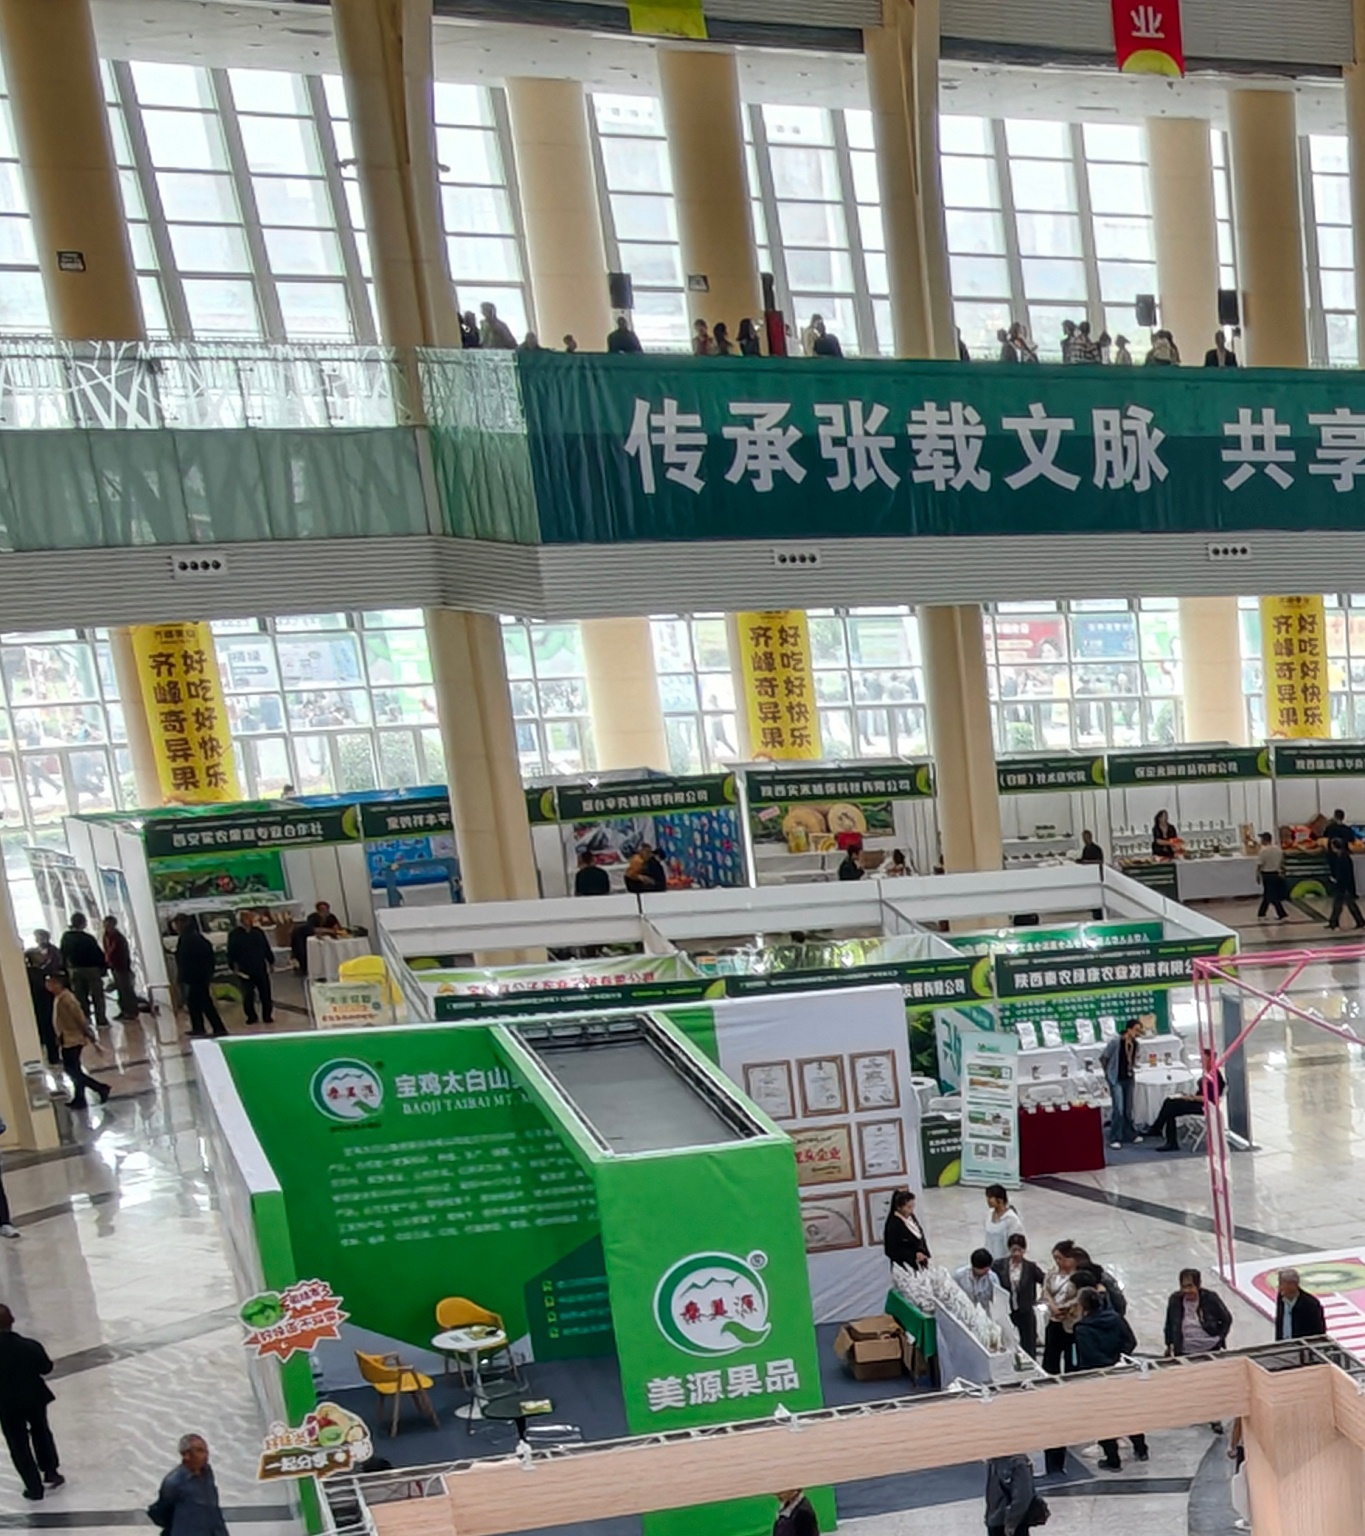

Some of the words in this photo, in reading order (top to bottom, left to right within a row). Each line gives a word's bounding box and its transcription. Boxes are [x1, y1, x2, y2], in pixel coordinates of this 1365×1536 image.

[1131, 5, 1167, 38] 业
[625, 398, 1170, 495] 传承张载文脉
[149, 652, 199, 790] 齐峰奇异果
[181, 650, 228, 789] 好吃好快乐
[749, 625, 784, 750] 齐峰奇异果
[779, 623, 813, 750] 好吃好快乐
[1297, 612, 1324, 727] 好吃好快乐
[395, 1066, 510, 1099] 宝鸡太白山
[403, 1101, 443, 1116] BAOJI
[647, 1358, 800, 1412] 美源果品
